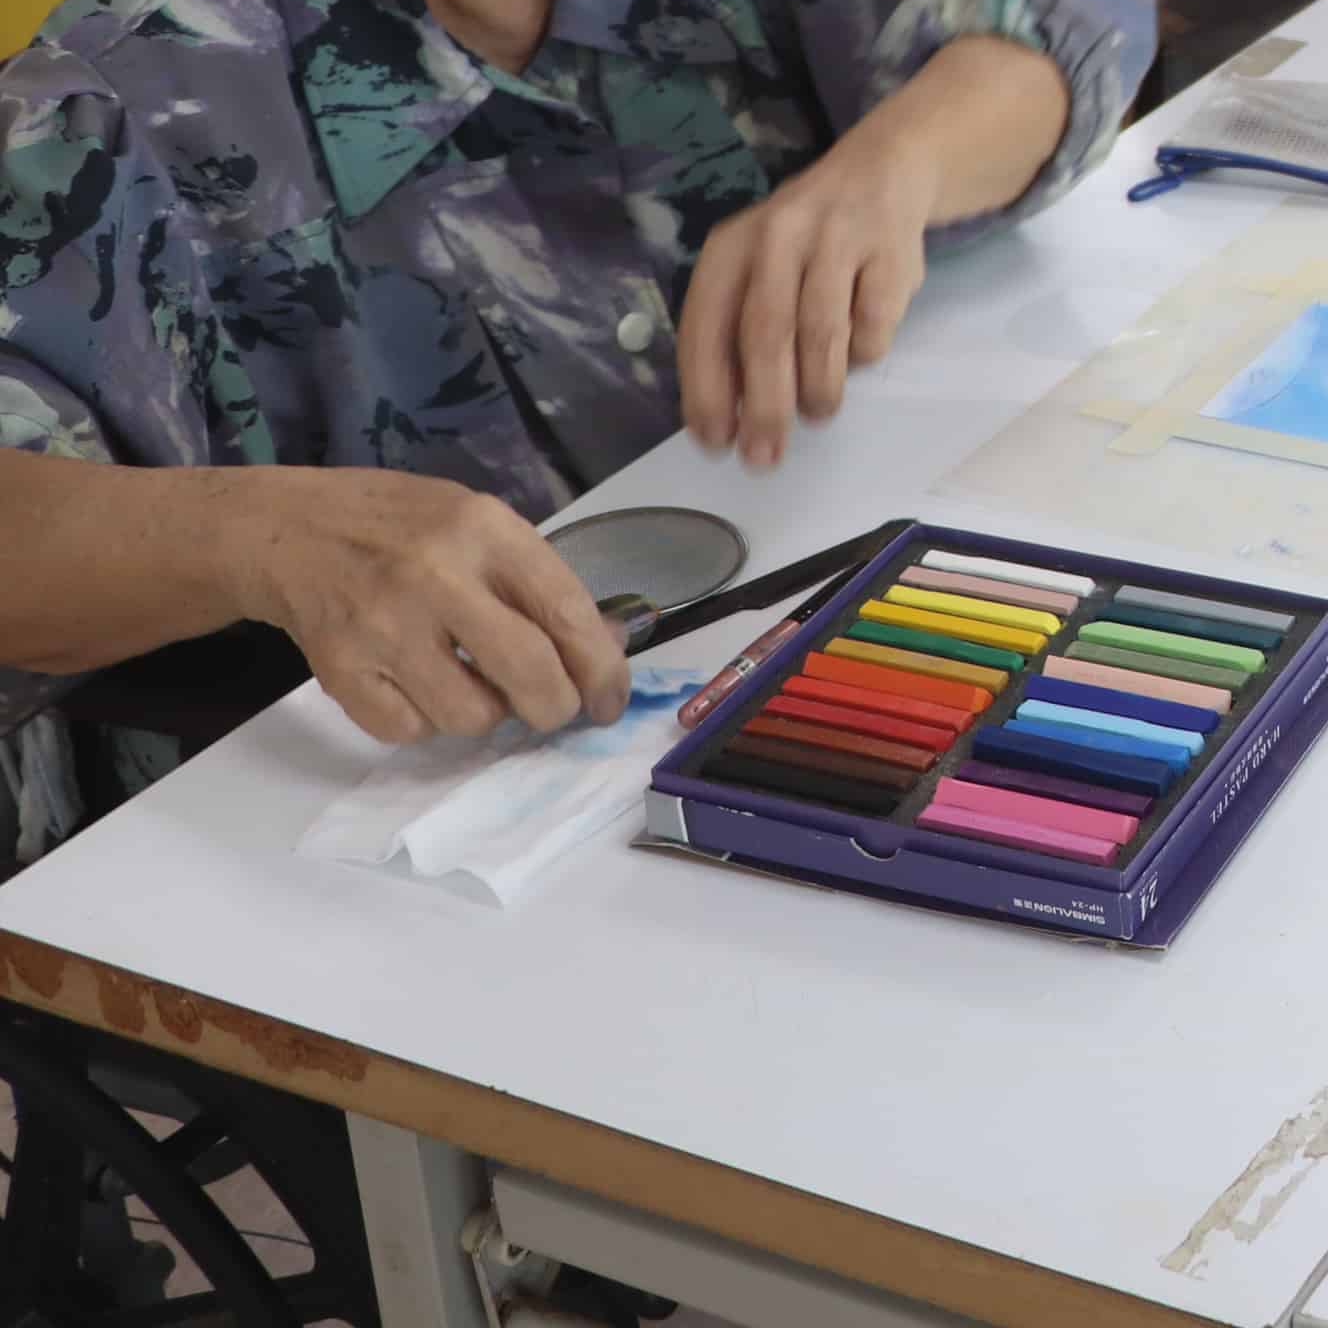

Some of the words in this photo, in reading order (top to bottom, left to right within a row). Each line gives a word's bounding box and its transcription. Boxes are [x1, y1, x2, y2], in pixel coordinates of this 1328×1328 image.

[1251, 724, 1281, 769] HARD
[1209, 766, 1249, 825] PASTEL
[1034, 902, 1106, 925] SIMBALION
[1071, 899, 1104, 914] HP-24
[1141, 878, 1159, 923] 24
